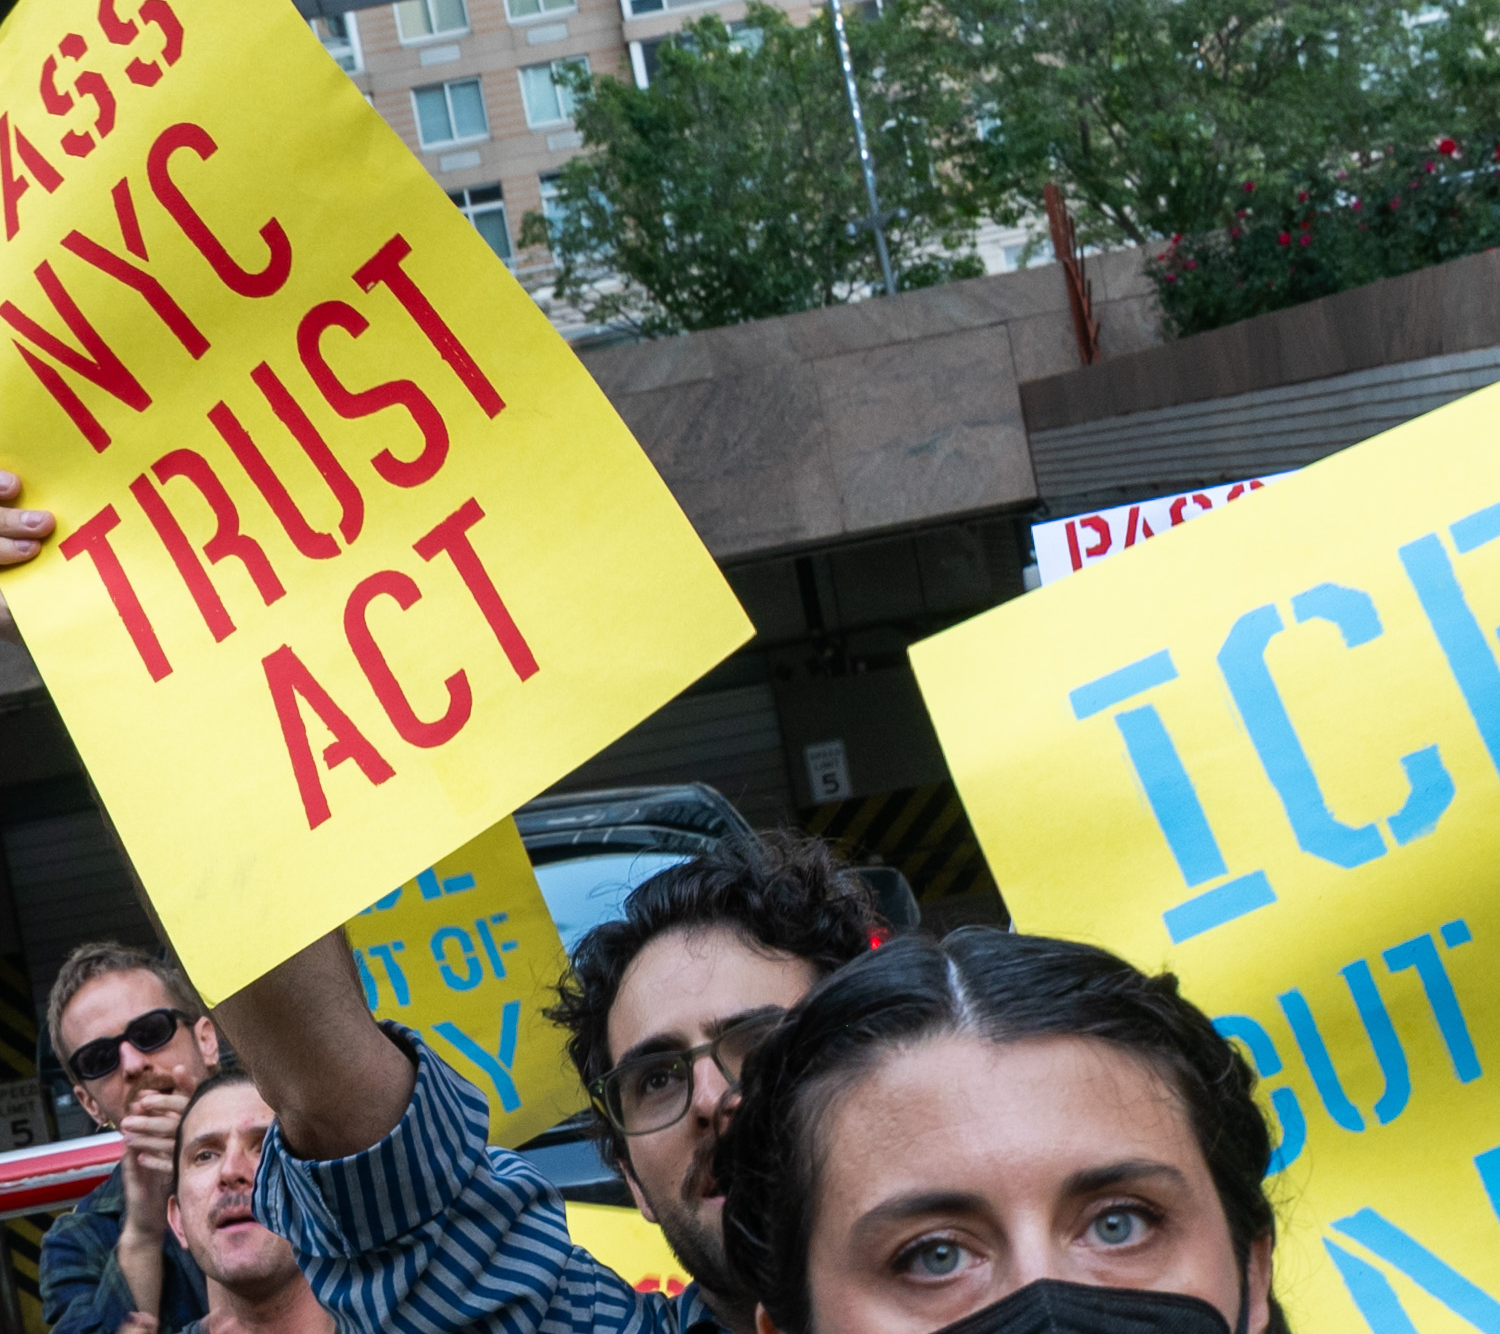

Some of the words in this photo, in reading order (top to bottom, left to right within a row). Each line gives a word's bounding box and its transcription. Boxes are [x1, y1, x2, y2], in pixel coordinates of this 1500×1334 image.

[59, 234, 506, 683] TRUST
[260, 498, 540, 831] ACT
[821, 772, 840, 795] 5
[429, 912, 518, 992] OF
[10, 1118, 34, 1147] 5
